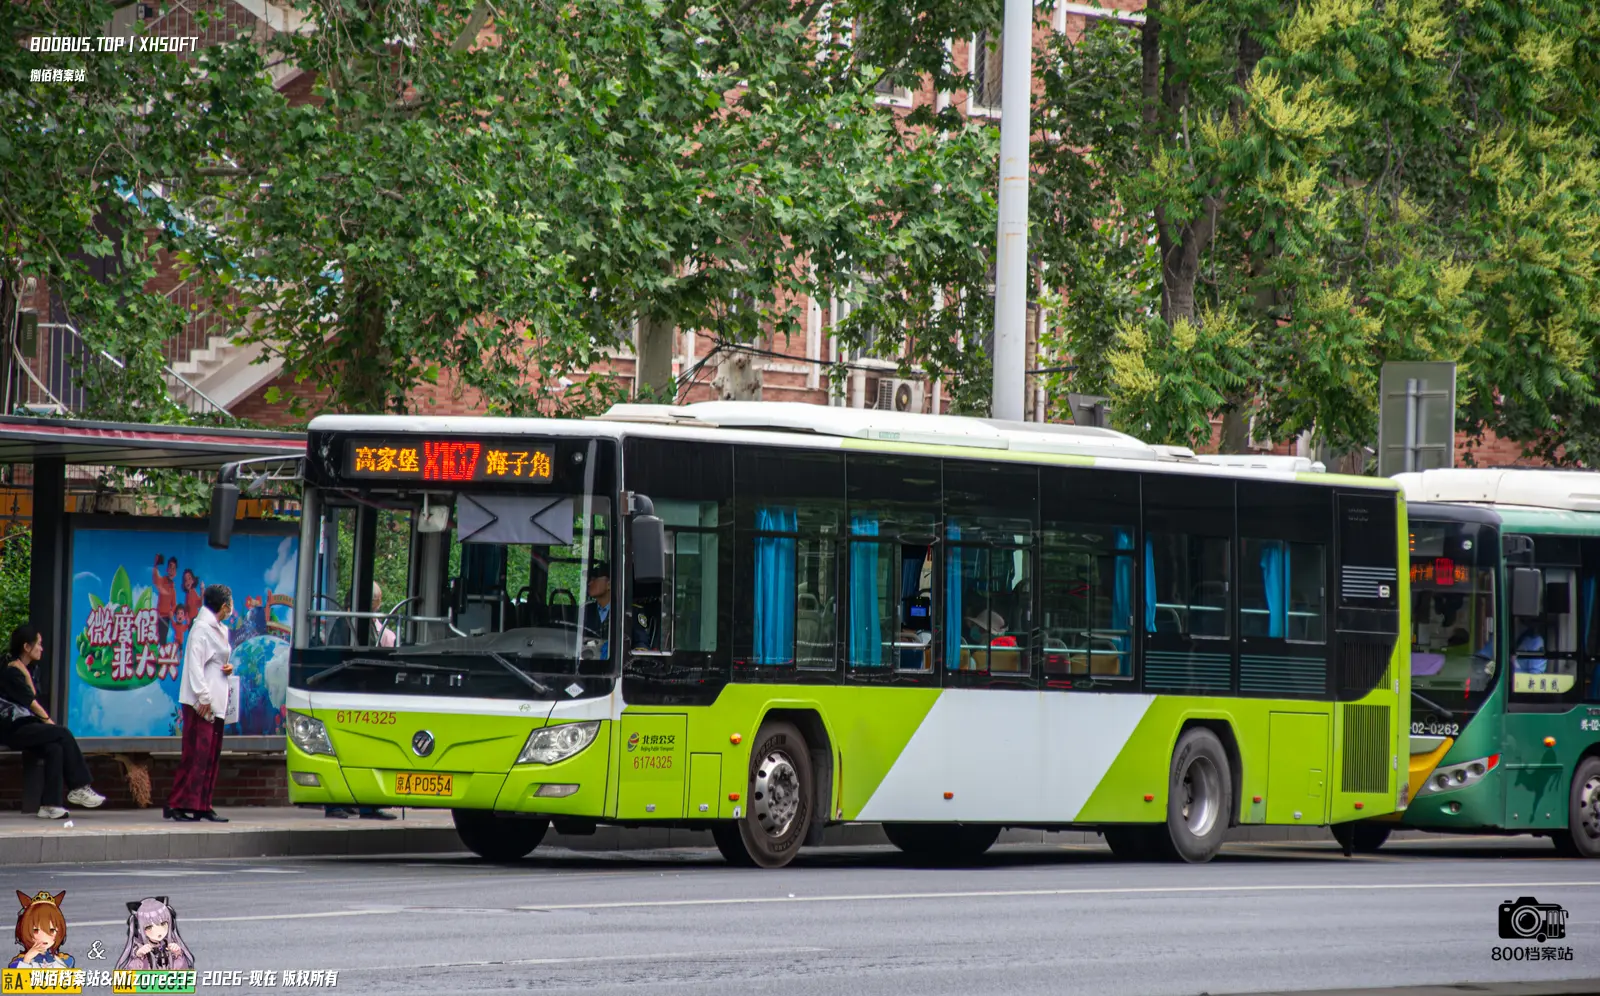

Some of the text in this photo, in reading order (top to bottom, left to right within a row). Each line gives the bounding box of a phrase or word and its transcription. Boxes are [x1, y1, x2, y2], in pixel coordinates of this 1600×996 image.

[355, 441, 551, 480] 高家堡 X107 海子角
[87, 605, 159, 645] 微度假
[111, 643, 181, 681] 来大兴
[336, 711, 397, 725] 6174325
[642, 735, 675, 745] 北京公交
[633, 756, 673, 770] 6174325
